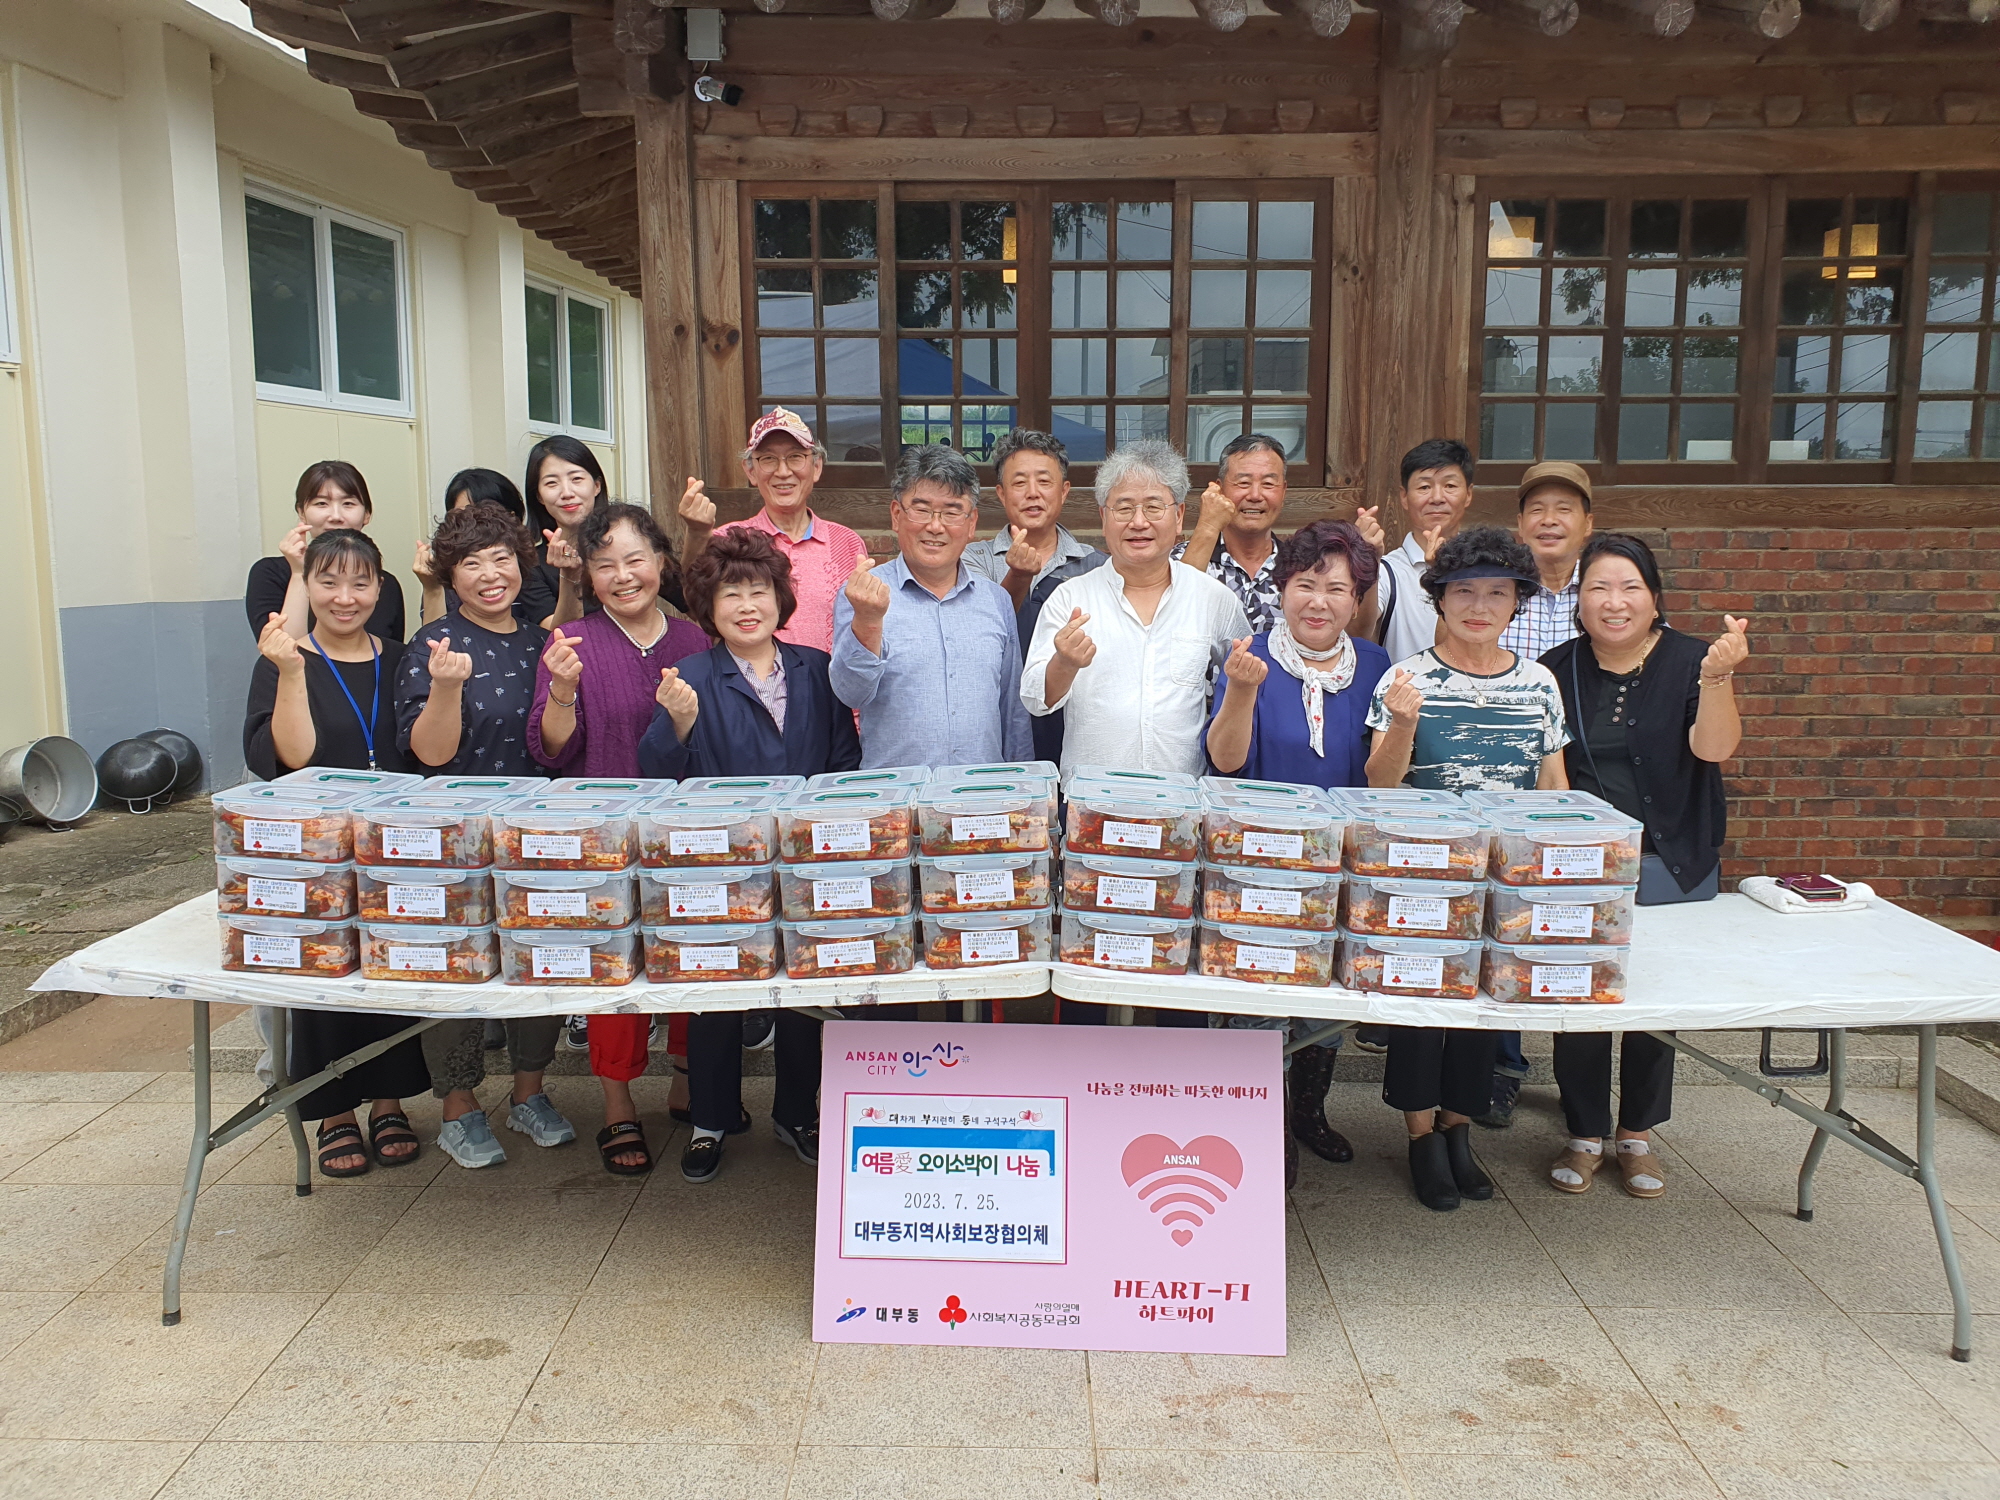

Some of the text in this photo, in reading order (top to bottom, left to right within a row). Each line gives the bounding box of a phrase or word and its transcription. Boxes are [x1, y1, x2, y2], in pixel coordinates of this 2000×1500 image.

[846, 1051, 898, 1062] ANSAN
[868, 1065, 896, 1076] CITY
[1087, 1082, 1125, 1096] 나눔을
[1128, 1083, 1181, 1098] 전파하는
[1184, 1085, 1225, 1098] 따듯한
[889, 1113, 1016, 1126] 대차게 부지런히 동네 구석구석
[916, 1153, 998, 1176] 오이소박이
[1006, 1154, 1040, 1178] 나눔
[1163, 1154, 1200, 1166] ANSAN
[904, 1192, 999, 1210] 2023. 7. 25.
[854, 1220, 1049, 1246] 대부동지역사회보장협의체
[1114, 1280, 1250, 1302] HEART-FI
[1034, 1302, 1080, 1312] 사랑의열매
[1138, 1304, 1214, 1324] 하트파이
[969, 1312, 1080, 1328] 사회복지공동모금회
